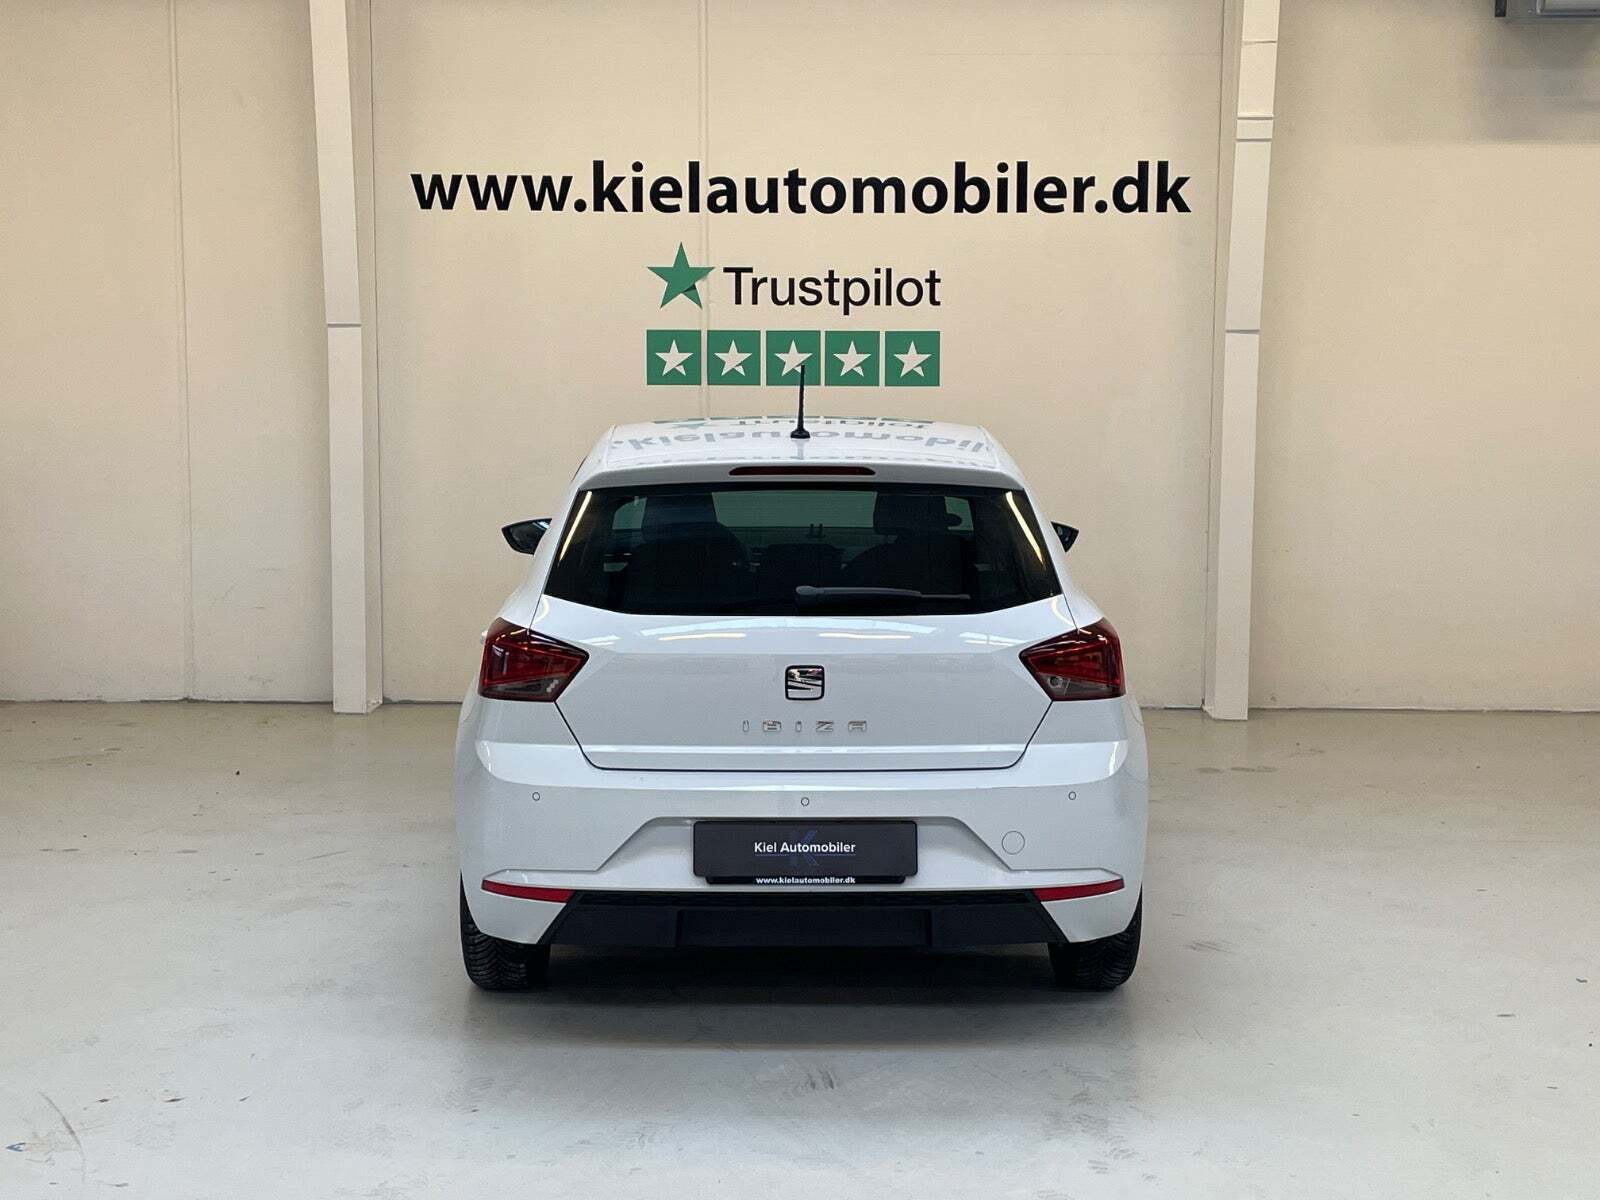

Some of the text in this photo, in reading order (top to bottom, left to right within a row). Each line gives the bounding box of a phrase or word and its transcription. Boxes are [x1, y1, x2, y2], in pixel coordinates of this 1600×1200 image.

[411, 160, 1192, 214] www.kielautomobiler.dk
[723, 266, 941, 315] Trustpilot
[742, 720, 868, 733] IBIZA
[754, 842, 856, 853] Kiel Automobiler
[756, 876, 856, 884] www.kielautomobiler.dk
